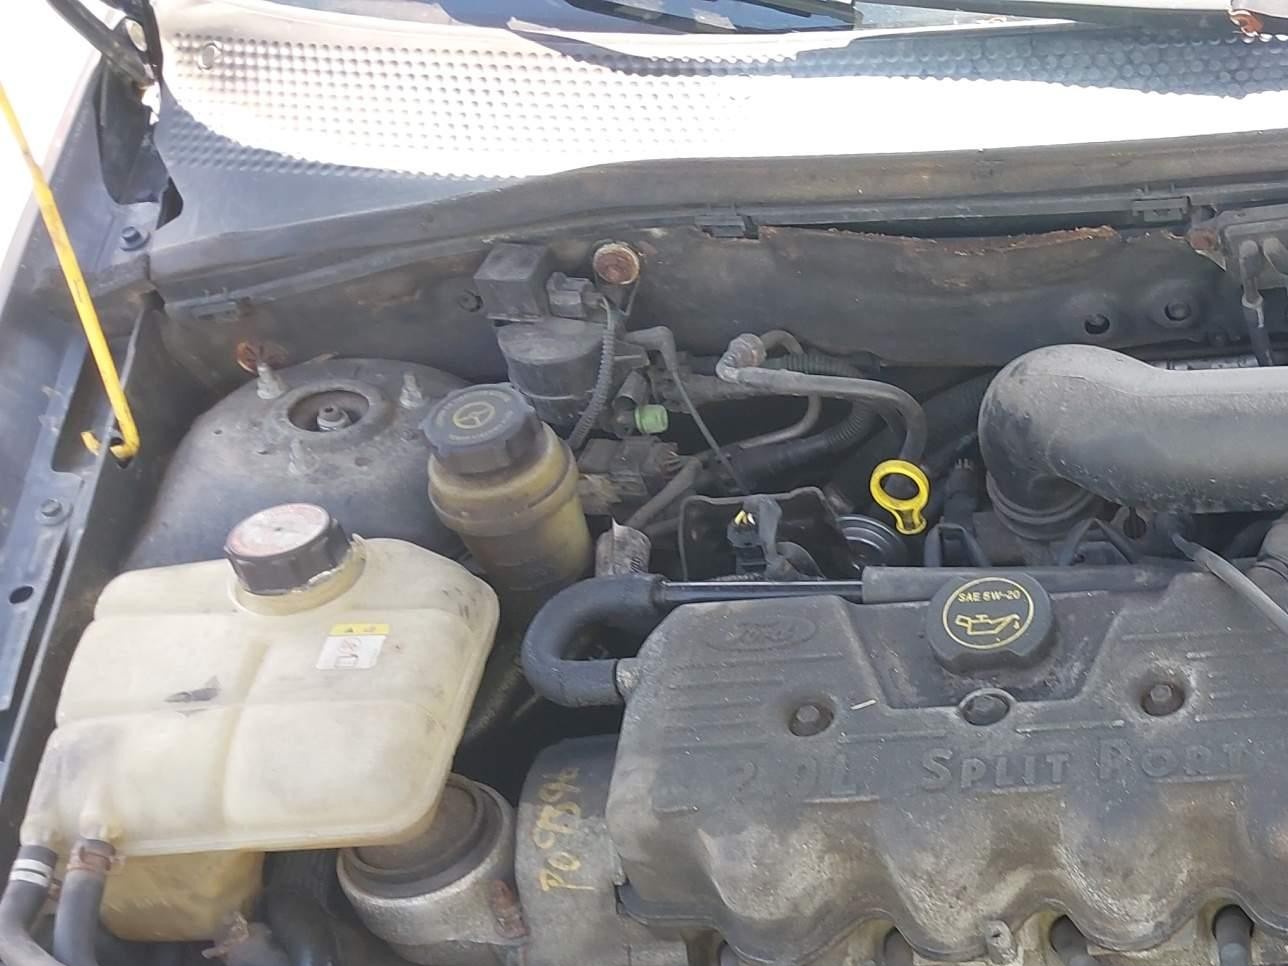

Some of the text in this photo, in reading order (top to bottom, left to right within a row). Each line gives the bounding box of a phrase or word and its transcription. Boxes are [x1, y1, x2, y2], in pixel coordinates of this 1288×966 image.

[958, 591, 982, 602] SAE
[920, 747, 1072, 791] SPLIT
[1095, 736, 1251, 781] PORT
